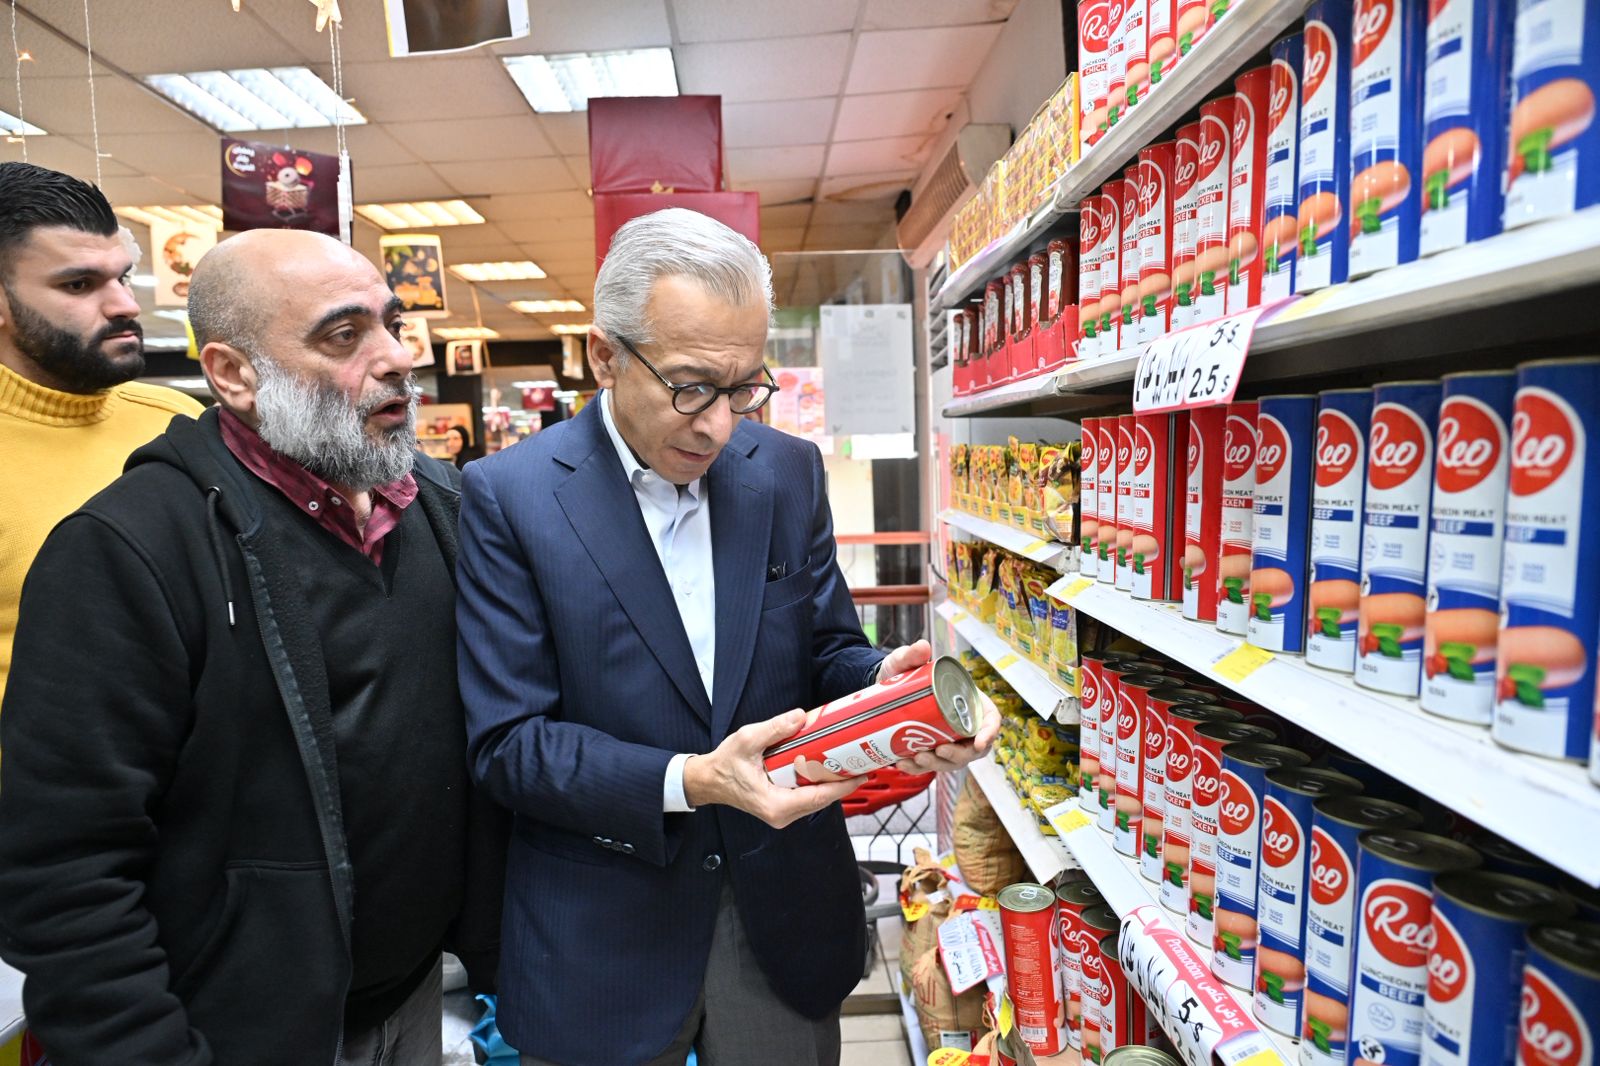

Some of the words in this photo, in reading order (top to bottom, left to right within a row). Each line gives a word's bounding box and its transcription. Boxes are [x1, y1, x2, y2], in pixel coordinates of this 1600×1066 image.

[1083, 15, 1109, 41] Re
[1085, 64, 1108, 76] CHICK
[1207, 183, 1223, 193] MEAT
[1183, 202, 1198, 211] MEAT
[1189, 364, 1220, 398] 2.5
[1134, 446, 1148, 461] eo
[1392, 504, 1420, 512] MEAT
[1165, 794, 1185, 807] CKEN
[1176, 790, 1191, 800] MEAT
[1219, 781, 1249, 821] Reo
[1204, 813, 1217, 825] MEA
[1233, 845, 1252, 857] MEAT
[1275, 880, 1296, 891] MEAT
[1323, 919, 1344, 932] MEAT
[1368, 895, 1431, 948] Reo
[1165, 938, 1206, 980] Promotion
[1361, 963, 1411, 988] LUNCHEON
[1414, 982, 1426, 991] ME
[1379, 983, 1418, 1002] BEEF
